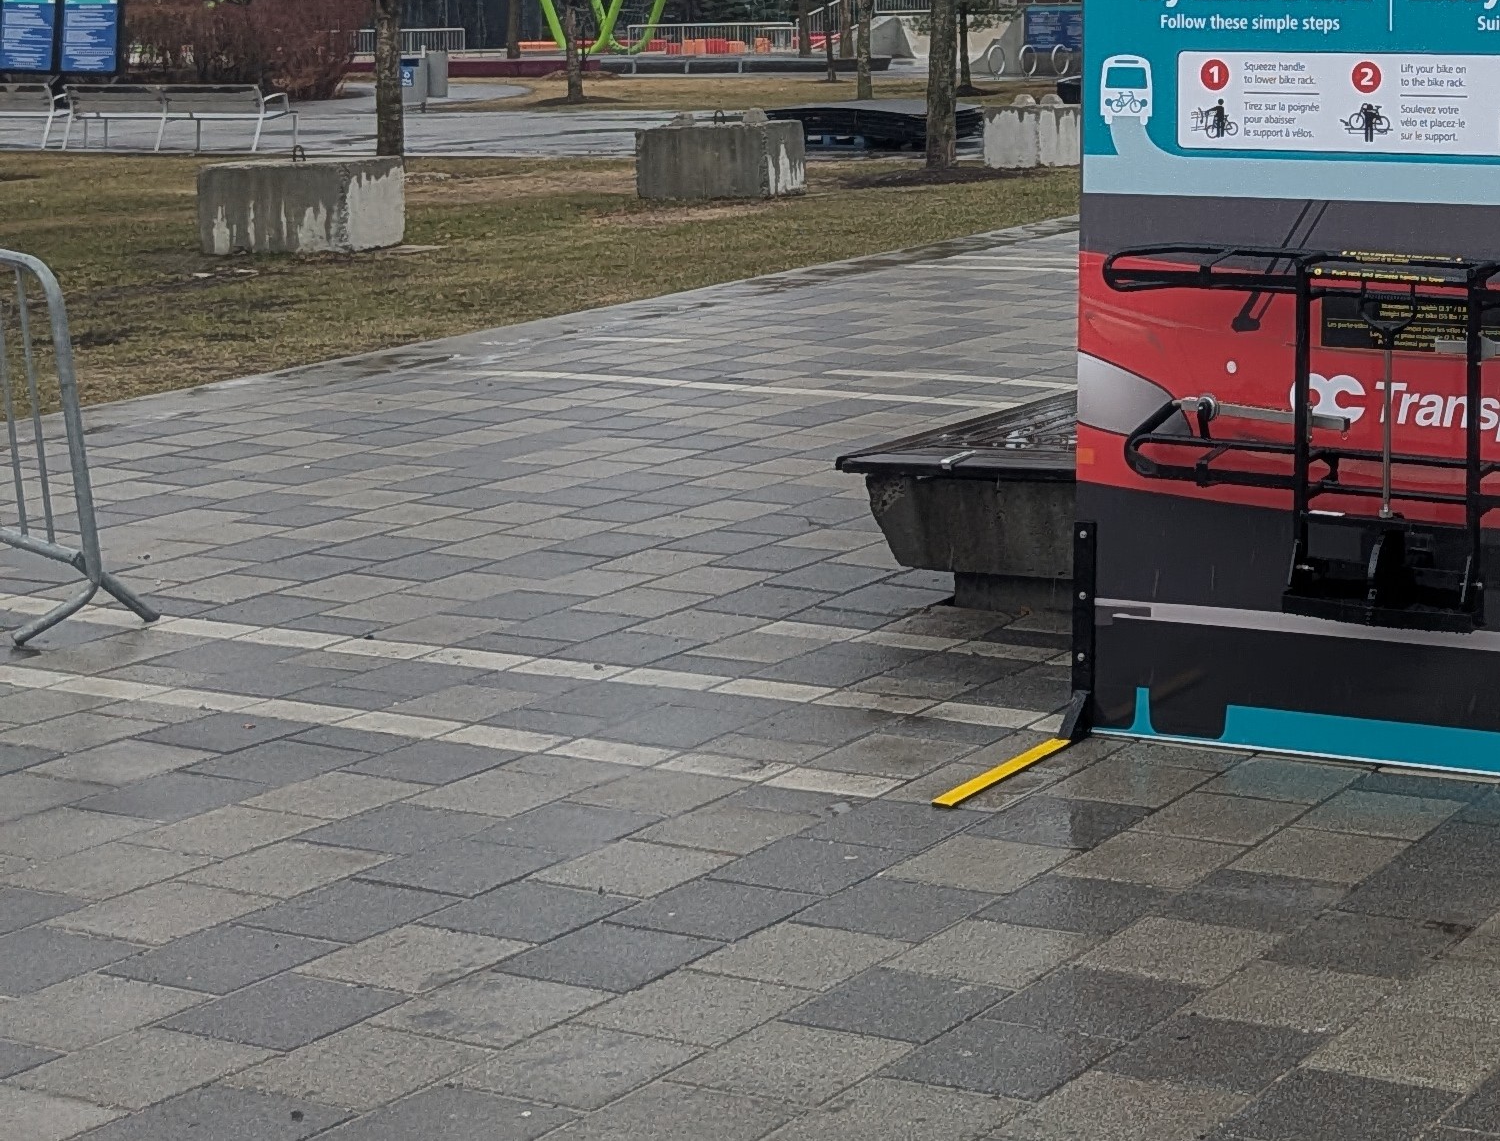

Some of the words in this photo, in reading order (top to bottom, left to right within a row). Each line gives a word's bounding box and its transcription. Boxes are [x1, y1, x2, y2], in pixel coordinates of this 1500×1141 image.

[1160, 14, 1206, 29] Follow
[1210, 14, 1248, 30] these
[1251, 14, 1298, 33] simple
[1302, 16, 1340, 34] steps
[1244, 61, 1277, 72] Squeeze
[1279, 61, 1306, 72] handle
[1400, 63, 1414, 74] Lift
[1416, 65, 1434, 76] your
[1436, 63, 1454, 74] bike
[1455, 66, 1467, 74] on
[1209, 65, 1219, 84] 1
[1244, 75, 1253, 84] to
[1254, 75, 1277, 84] lower
[1279, 75, 1296, 85] bike
[1360, 67, 1374, 86] 2
[1400, 77, 1409, 87] to
[1412, 77, 1426, 87] the
[1427, 77, 1445, 87] bike
[1244, 101, 1263, 111] Tirez
[1265, 103, 1277, 111] sur
[1279, 101, 1286, 111] la
[1287, 102, 1320, 114] poignée
[1400, 104, 1437, 114] Soulevez
[1438, 105, 1460, 115] votre
[1244, 116, 1263, 126] pour
[1264, 114, 1297, 125] abaisser
[1400, 117, 1417, 128] vélo
[1419, 118, 1428, 128] et
[1244, 127, 1251, 137] le
[1253, 129, 1283, 139] support
[1400, 132, 1412, 141] sur
[1415, 130, 1423, 141] le
